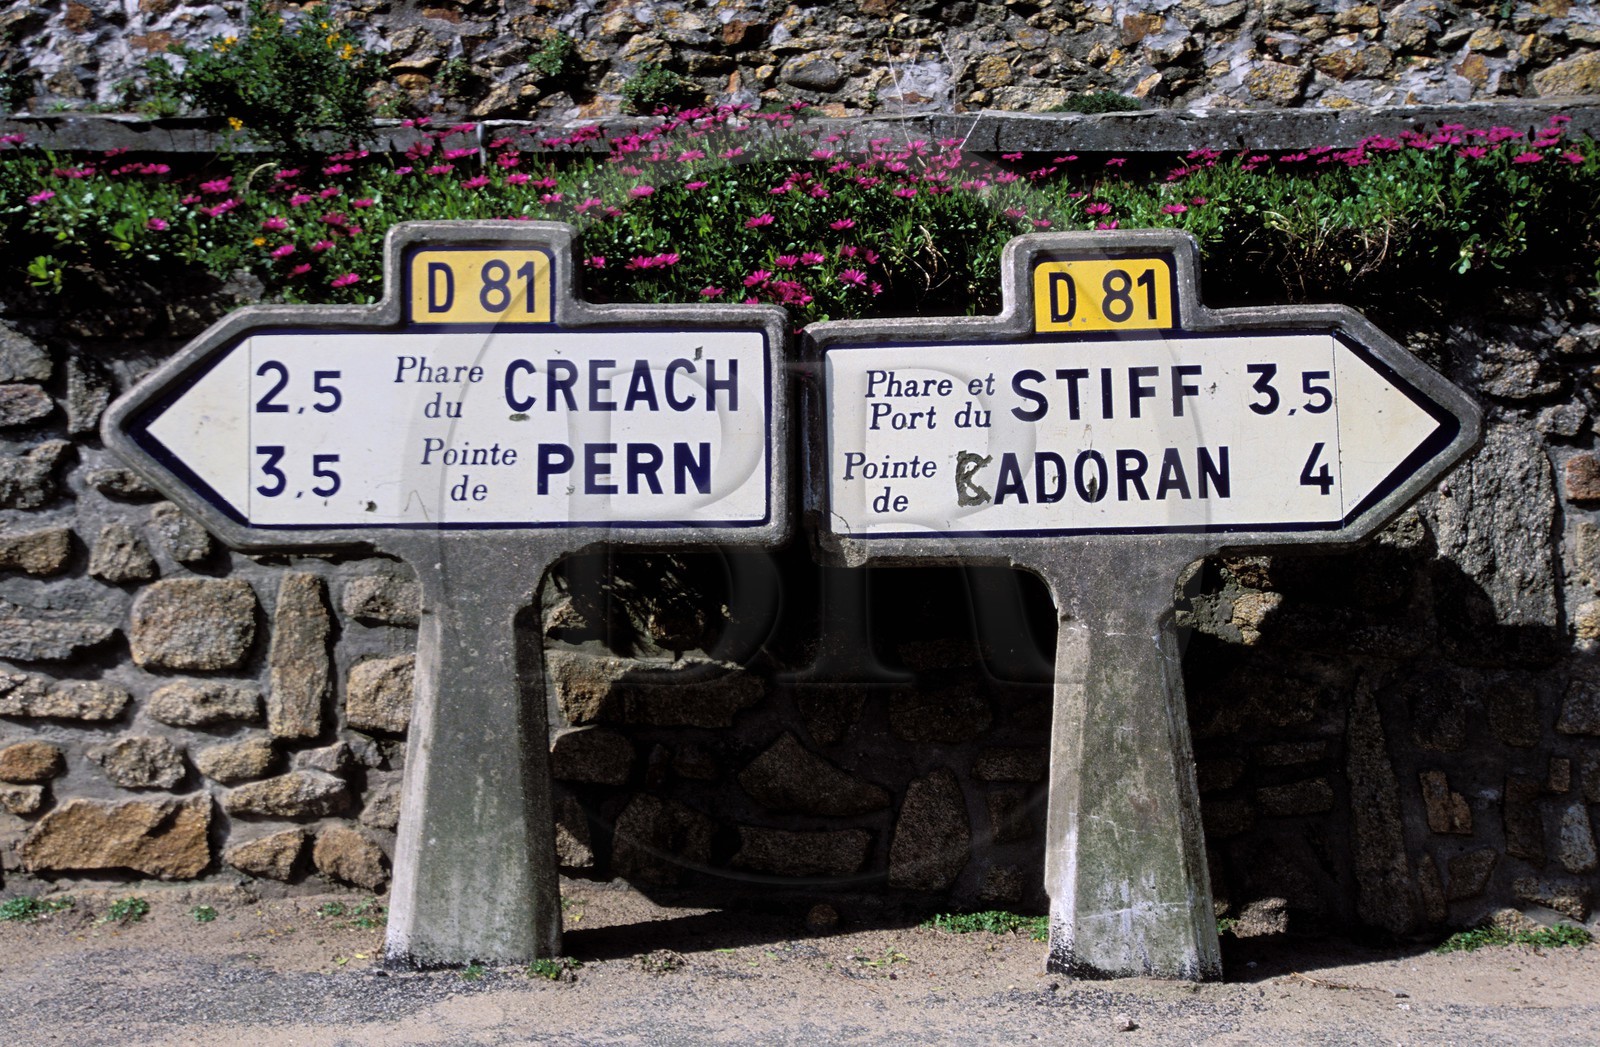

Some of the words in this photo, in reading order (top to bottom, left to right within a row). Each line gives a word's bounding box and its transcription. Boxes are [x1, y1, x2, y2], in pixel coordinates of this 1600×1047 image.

[428, 262, 454, 313] D
[480, 260, 535, 313] 81
[1049, 271, 1077, 323] D
[1102, 268, 1158, 323] 81
[256, 360, 341, 415] 2,5
[394, 357, 484, 383] Phare
[865, 370, 953, 398] Phare
[968, 373, 996, 396] et
[1247, 363, 1333, 416] 3,5
[425, 396, 463, 419] du
[1011, 364, 1203, 423] STIFF
[870, 403, 937, 431] Port
[955, 402, 992, 429] du
[256, 445, 341, 499] 3,5
[421, 438, 518, 466] Pointe
[537, 443, 712, 496] PERN
[843, 452, 937, 482] Pointe
[1300, 443, 1334, 496] 4
[451, 475, 488, 502] de
[873, 490, 909, 514] de
